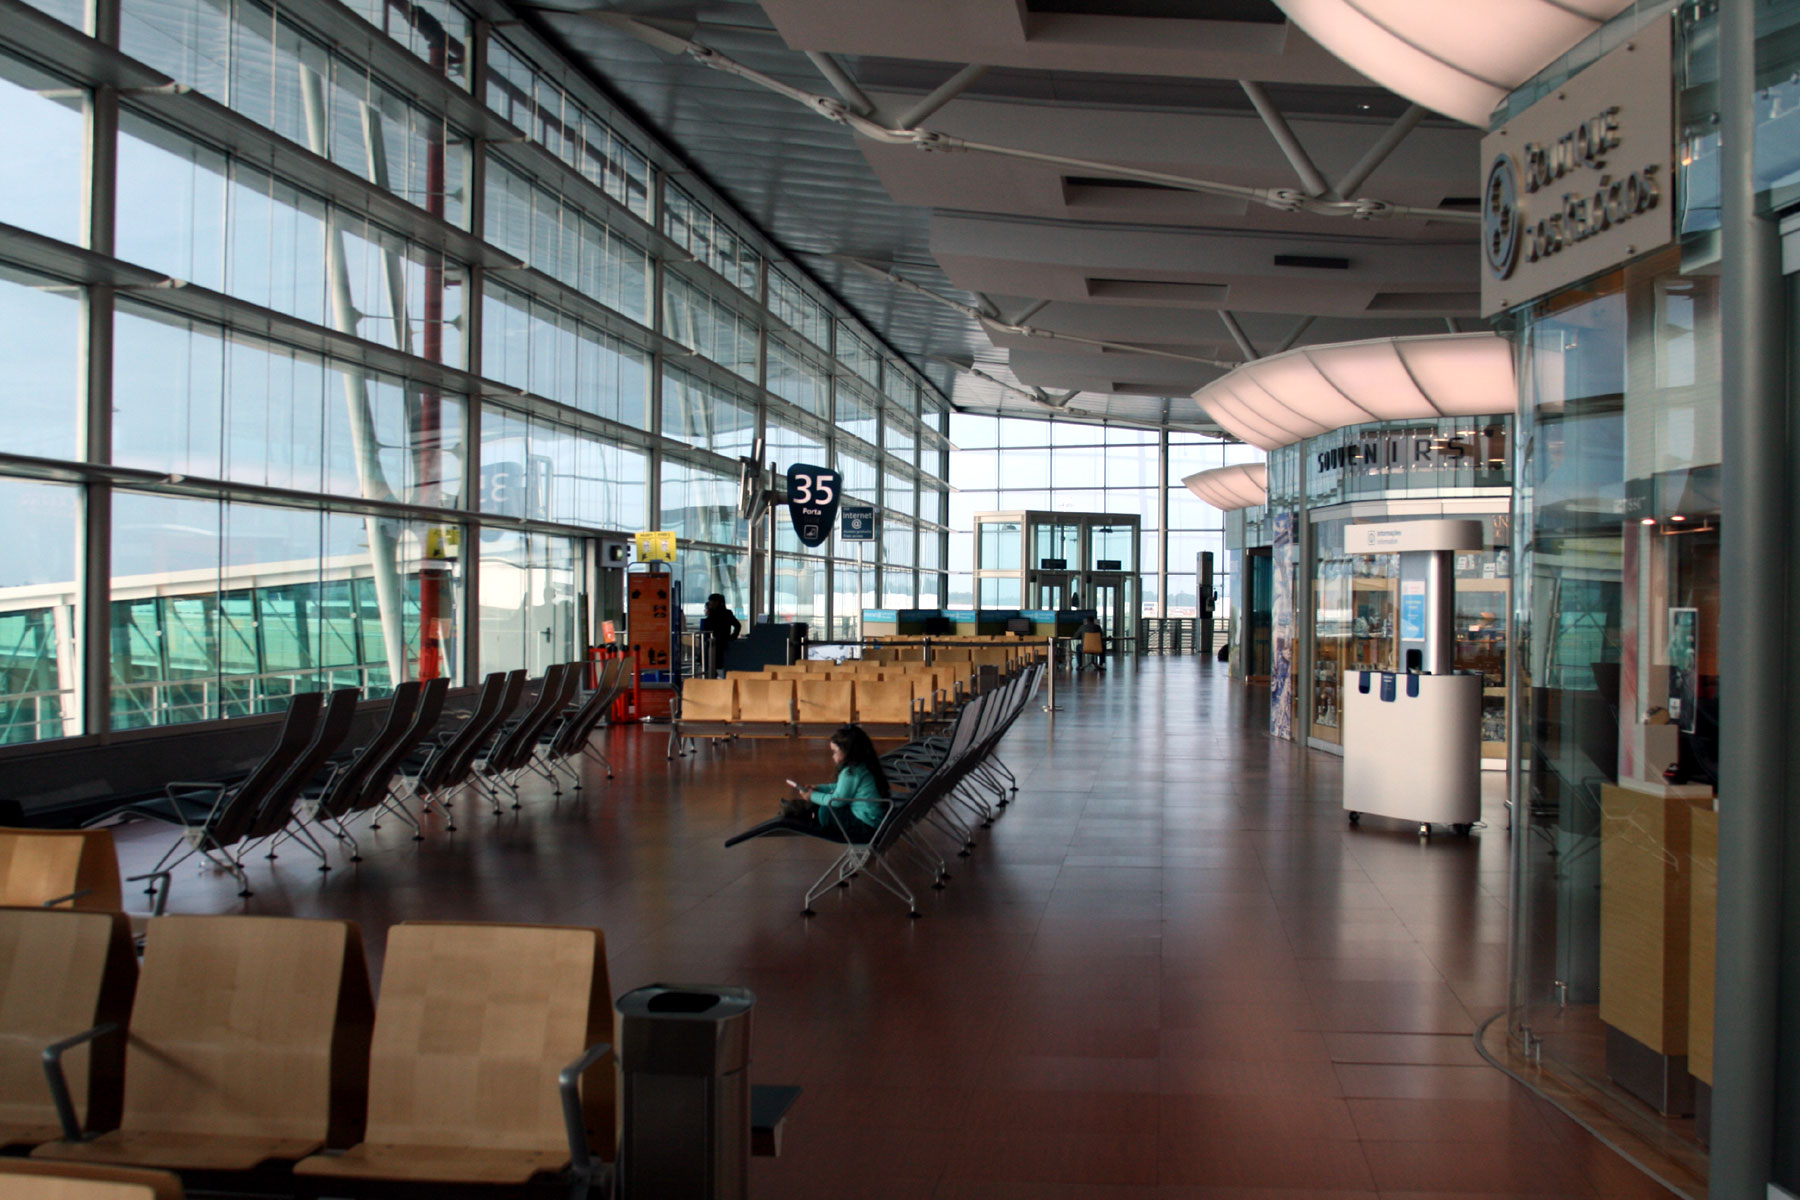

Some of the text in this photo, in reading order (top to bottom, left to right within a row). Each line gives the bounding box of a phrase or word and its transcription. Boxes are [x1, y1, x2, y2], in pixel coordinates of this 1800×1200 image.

[1317, 436, 1465, 474] SOUVENIRS
[793, 474, 834, 505] 35
[802, 507, 822, 516] Porta
